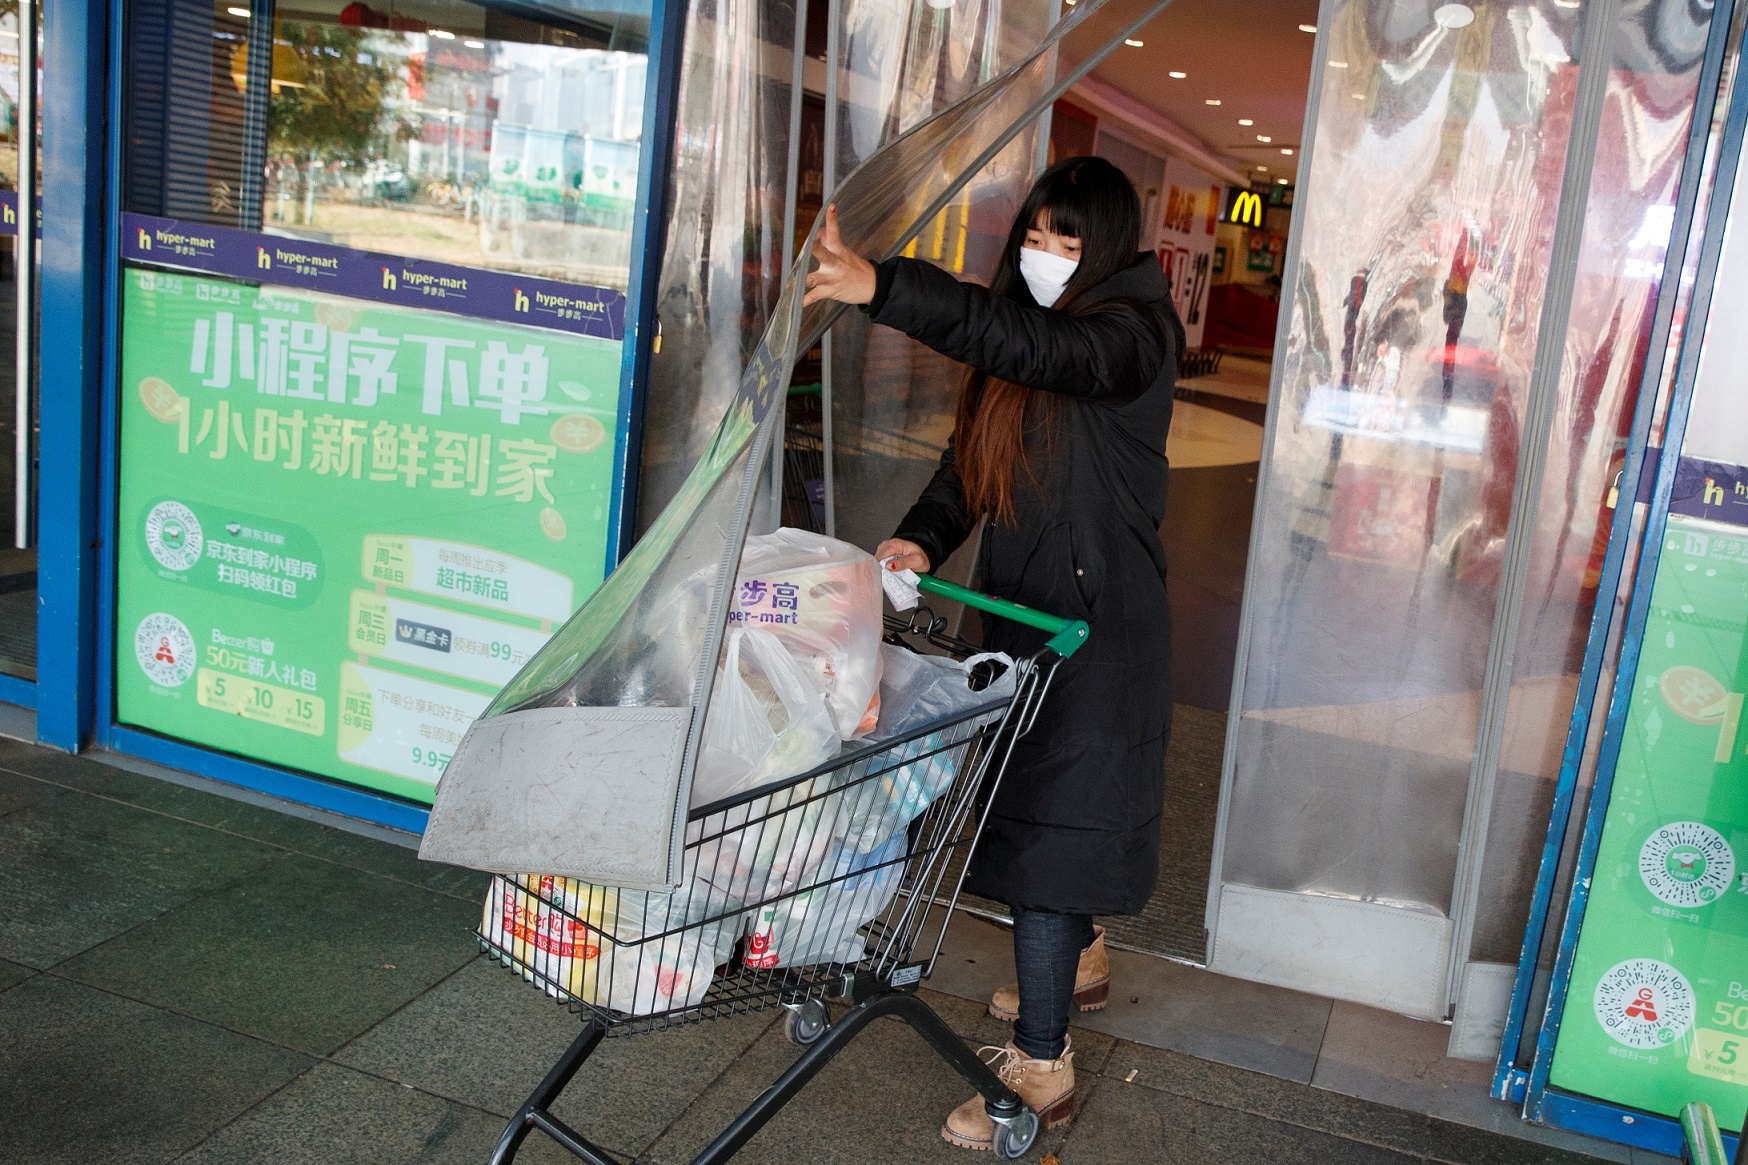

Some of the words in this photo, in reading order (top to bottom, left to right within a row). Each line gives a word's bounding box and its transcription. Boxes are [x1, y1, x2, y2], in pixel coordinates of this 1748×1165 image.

[156, 229, 215, 249] hyper-mart
[276, 249, 338, 269] hyper-mart
[402, 269, 467, 290] hyper-mart
[535, 291, 605, 313] hyper-mart
[189, 311, 550, 425] 小程序下单
[165, 396, 557, 505] 1小时新鲜到家
[206, 539, 318, 581] 京东到家小程序
[376, 547, 403, 565] 周一
[438, 548, 508, 574] 每周推出应季
[218, 563, 297, 599] 扫码领红包
[372, 565, 404, 583] 新品日
[436, 566, 509, 602] 超市新品
[359, 610, 385, 630] 周三
[414, 628, 449, 646] 黑金卡
[453, 636, 533, 666] 领券满99元
[207, 645, 318, 691] 50元新人礼包
[345, 697, 372, 717] 周五
[342, 713, 373, 732] 分享日
